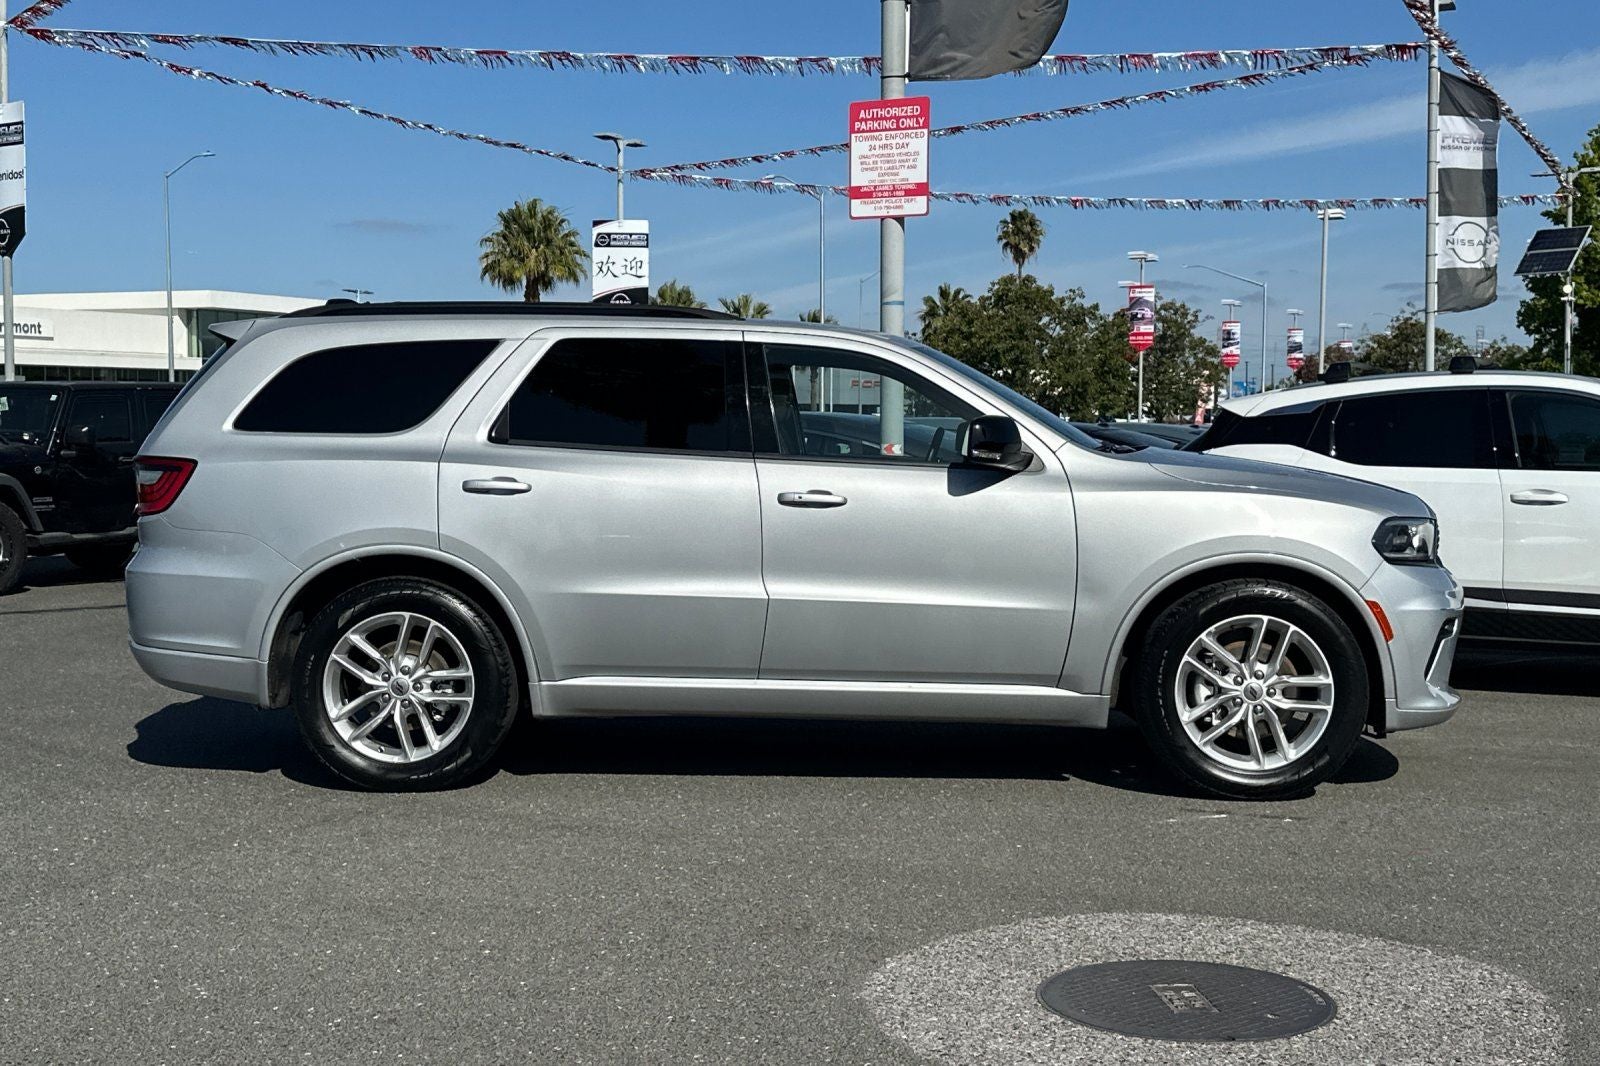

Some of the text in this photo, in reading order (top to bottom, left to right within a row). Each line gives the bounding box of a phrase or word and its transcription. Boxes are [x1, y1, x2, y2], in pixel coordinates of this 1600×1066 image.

[859, 105, 920, 119] AUTHORIZED
[854, 117, 925, 131] PARKING ONLY
[854, 131, 925, 142] TOWING ENFORCED
[1446, 238, 1492, 246] NISSAN
[595, 255, 646, 279] 欢迎
